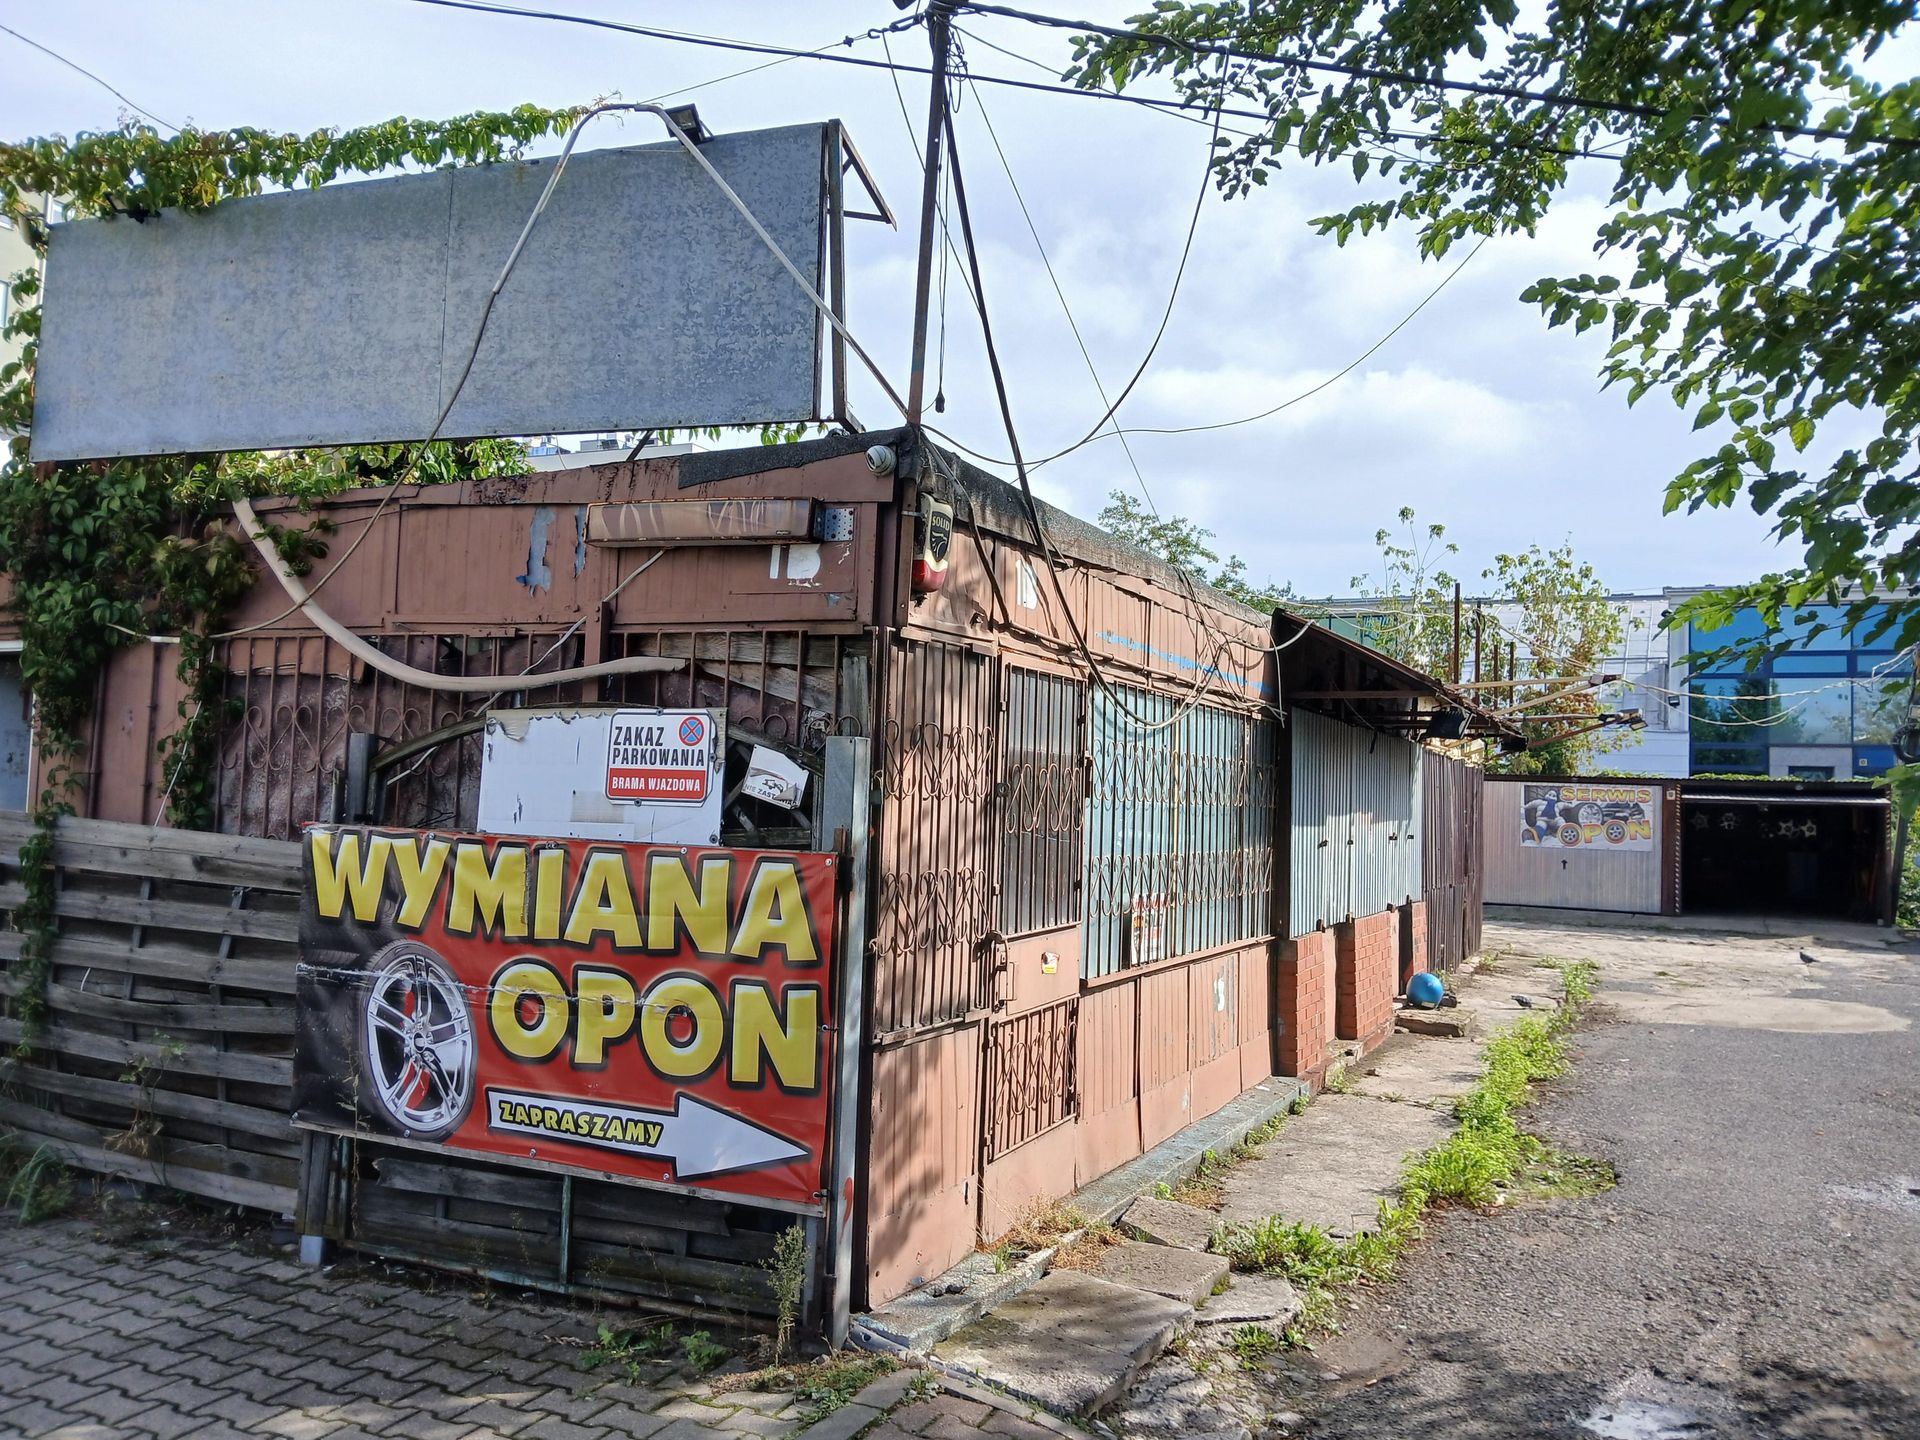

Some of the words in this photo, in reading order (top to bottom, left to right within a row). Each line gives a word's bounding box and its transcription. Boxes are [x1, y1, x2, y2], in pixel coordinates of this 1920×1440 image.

[932, 516, 950, 531] SOLID
[613, 726, 664, 747] ZAKAZ
[612, 747, 704, 767] PARKOWANIA
[612, 776, 645, 791] BRAMA
[648, 776, 701, 792] WJAZDOWA
[1560, 787, 1651, 803] SERWIS
[1559, 819, 1651, 846] OPON
[310, 831, 818, 962] WYMIANA
[488, 960, 818, 1091] OPON
[499, 1100, 663, 1146] ZAPRASZAMY
